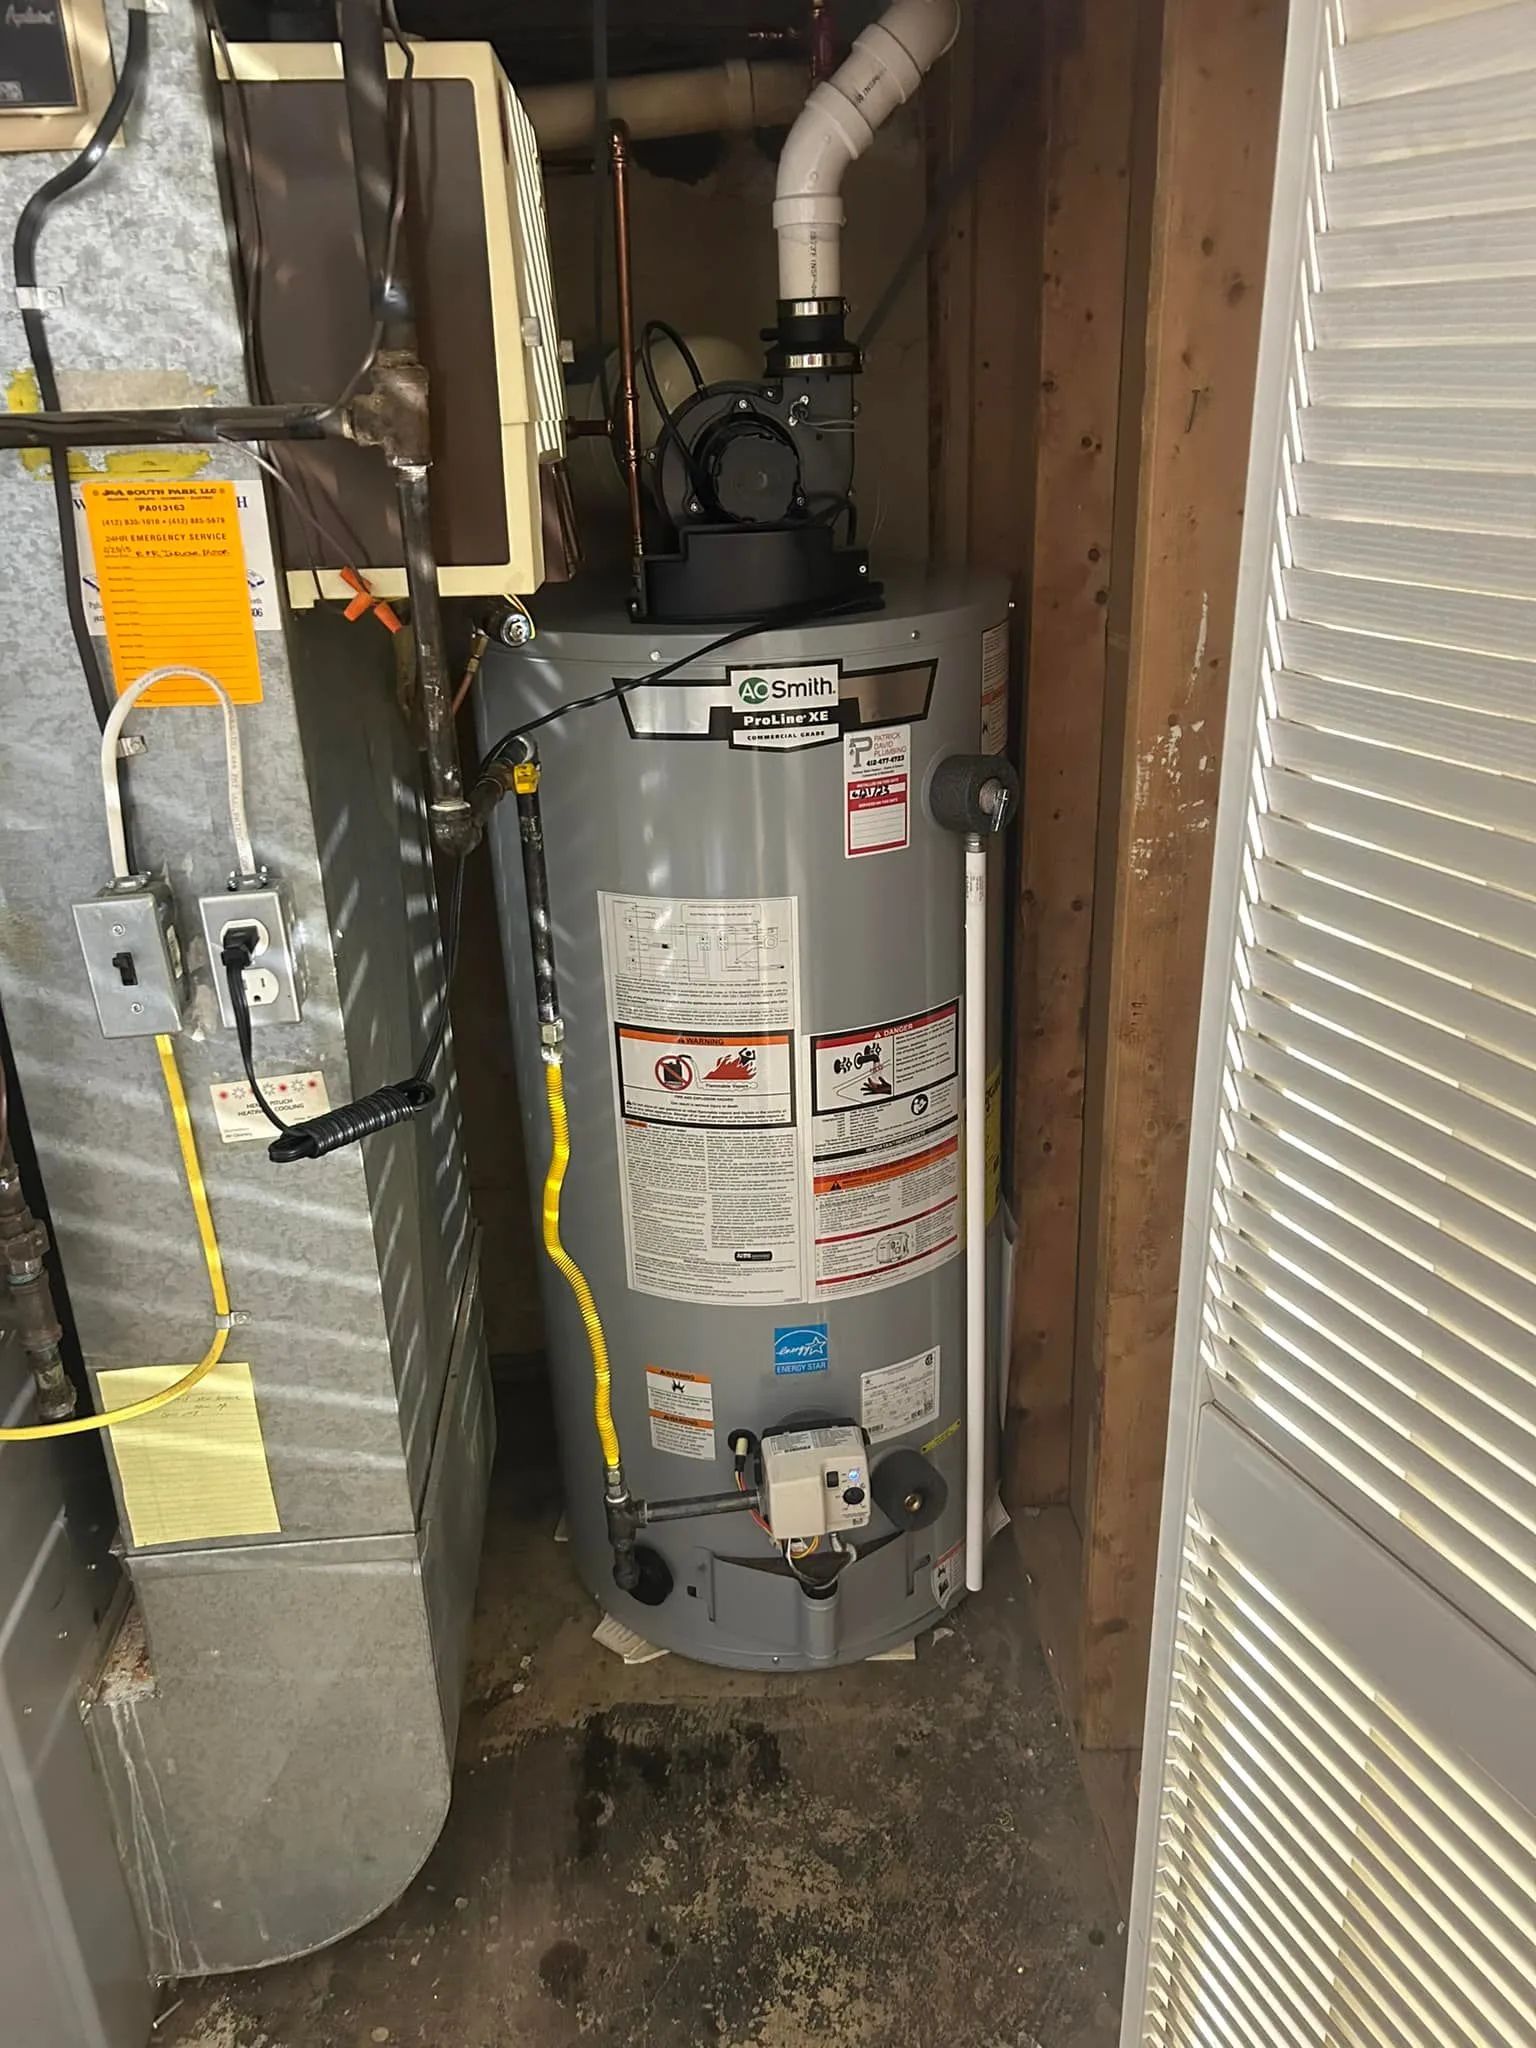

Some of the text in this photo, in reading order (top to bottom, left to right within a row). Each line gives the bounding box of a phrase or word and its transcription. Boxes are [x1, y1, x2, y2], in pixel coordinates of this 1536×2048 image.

[130, 533, 185, 542] EMERGENCY
[189, 532, 227, 540] SERVICE
[808, 710, 829, 722] XE
[747, 733, 797, 741] COMMERCIAL
[874, 745, 907, 757] PLUMBING
[884, 1024, 913, 1036] DANGER
[687, 1037, 725, 1046] WARNING
[274, 1104, 304, 1112] COOLING
[777, 1361, 826, 1373] ENERGY STAR
